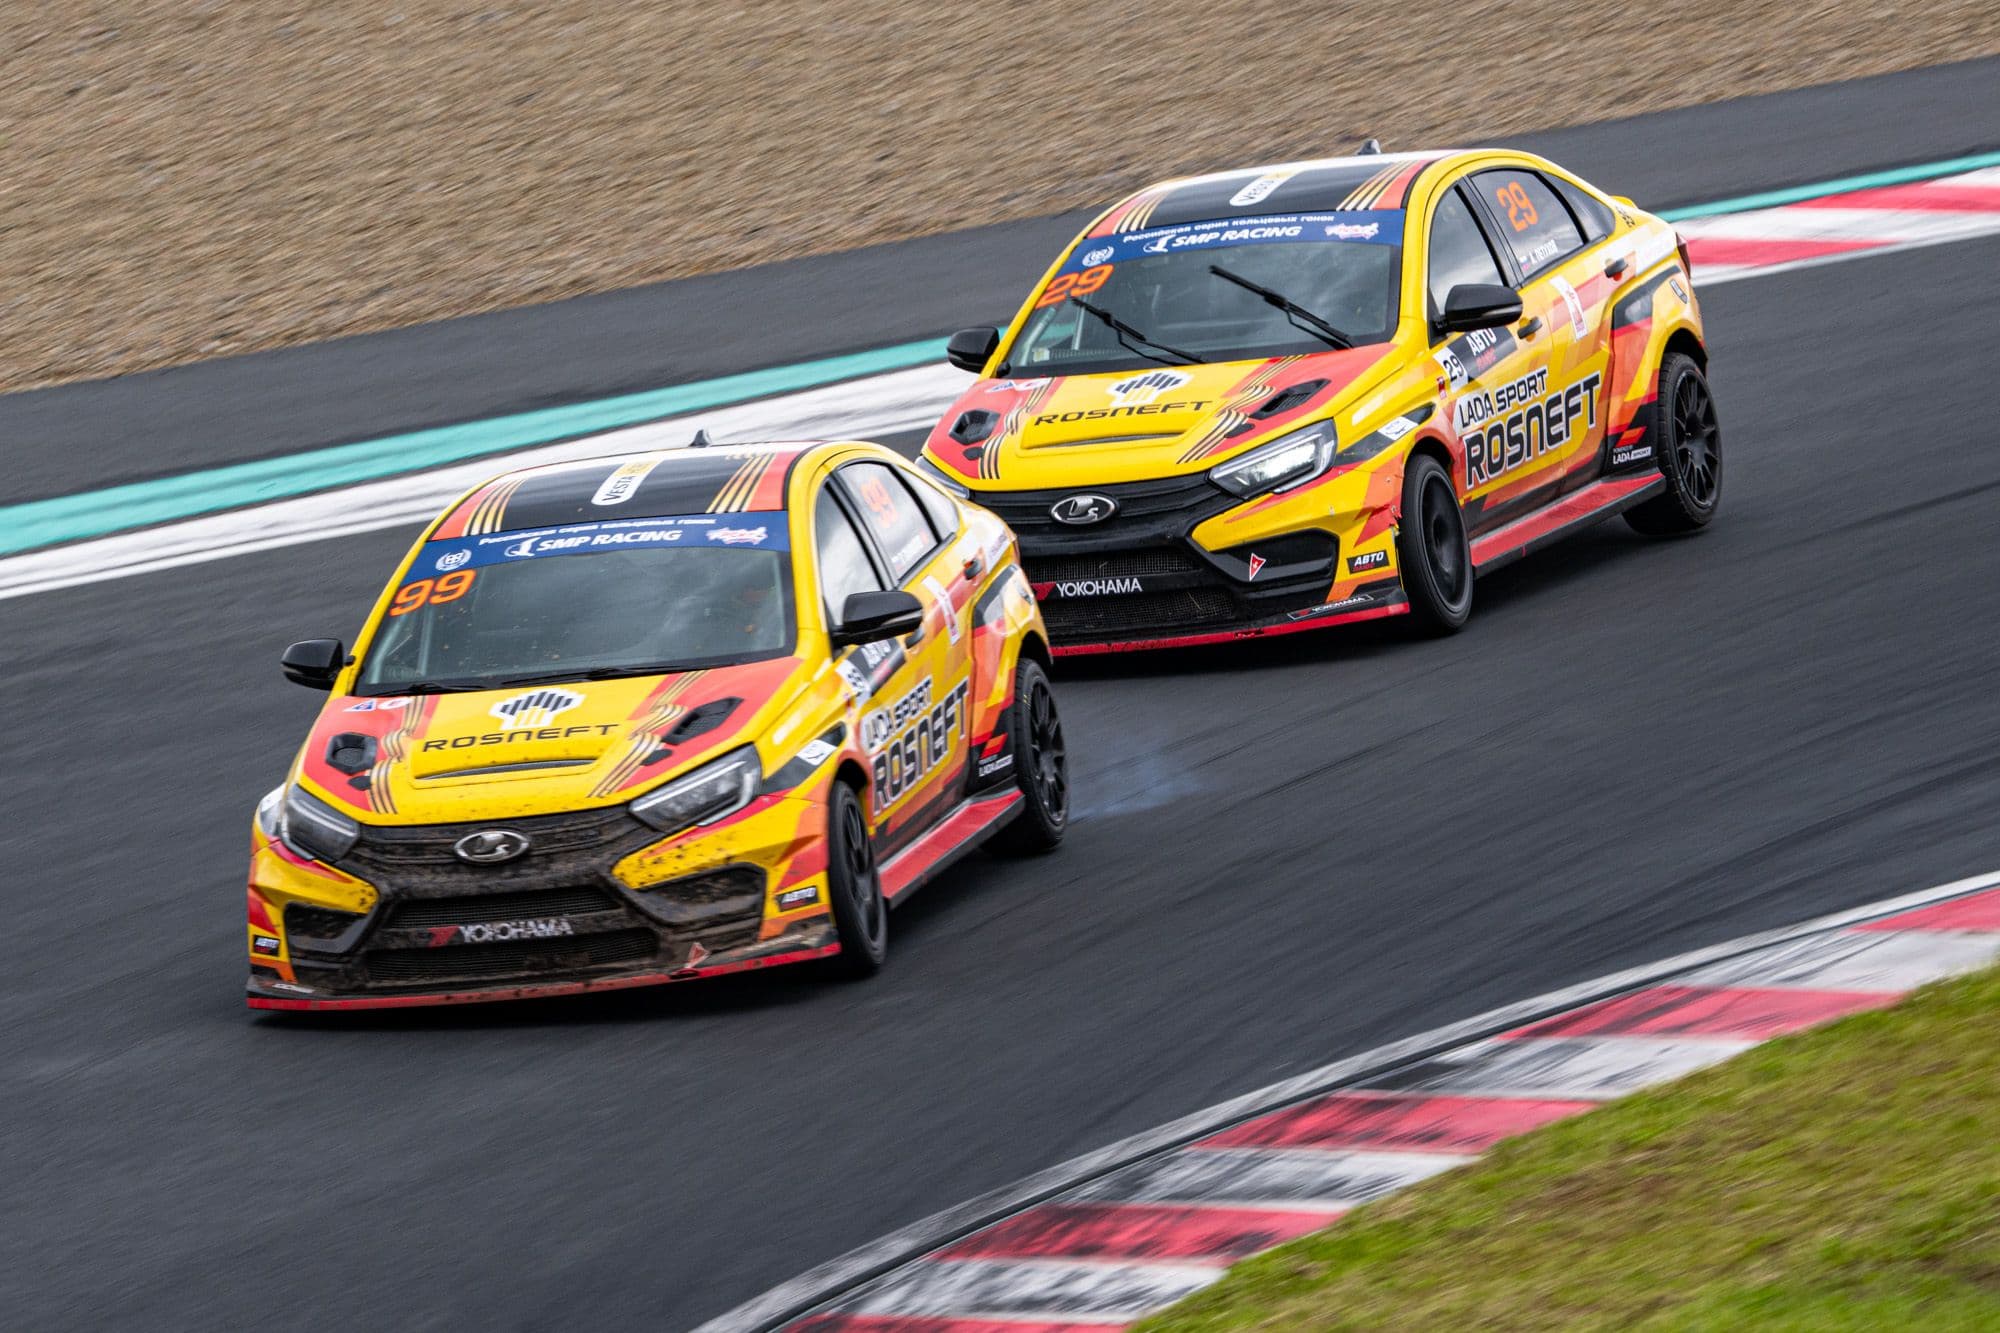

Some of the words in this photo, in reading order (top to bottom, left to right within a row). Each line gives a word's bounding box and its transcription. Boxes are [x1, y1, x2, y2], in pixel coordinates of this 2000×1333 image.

[1496, 181, 1540, 232] 29
[1172, 231, 1220, 247] SMP
[1220, 226, 1303, 242] RACING
[1034, 263, 1114, 310] 29
[1443, 354, 1465, 382] 29
[1034, 400, 1214, 426] ROSNEFT
[1459, 392, 1495, 429] LADA
[1496, 367, 1548, 412] SPORT
[1463, 371, 1601, 490] ROSNEFT
[537, 536, 592, 551] SMP
[591, 529, 683, 545] RACING
[389, 569, 477, 617] 99
[1056, 577, 1143, 598] YOKOHAMA
[422, 723, 620, 753] ROSNEFT
[873, 676, 970, 816] ROSNEFT
[459, 918, 574, 943] YOKOHAMA
